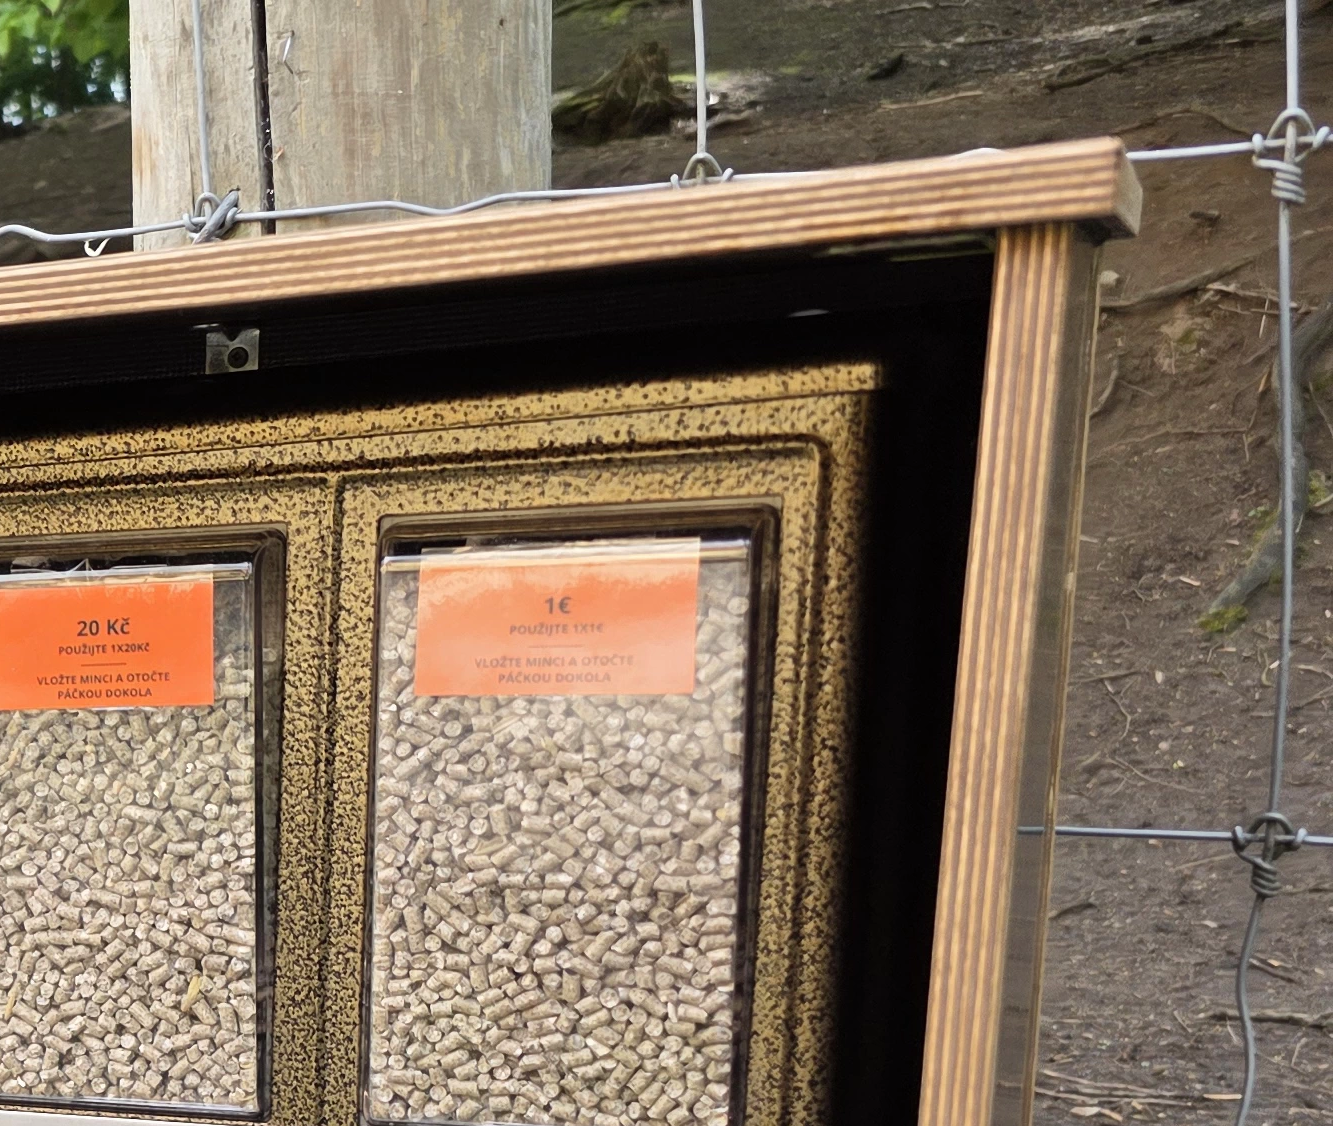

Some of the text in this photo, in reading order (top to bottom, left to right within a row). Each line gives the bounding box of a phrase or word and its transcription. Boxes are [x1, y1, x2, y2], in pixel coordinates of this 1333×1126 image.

[544, 596, 572, 614] 1€
[77, 617, 130, 637] 20 Kč
[509, 623, 604, 636] POUŽIJTE 1X1€
[58, 643, 107, 656] POUŽIJTE
[474, 653, 634, 669] VLOŽTE MINCI A OTOČTE
[37, 670, 170, 686] VLOŽTE MINCI A OTOČTE
[498, 671, 611, 684] PÁČKOU DOKOLA
[58, 688, 152, 700] PÁČKOU DOKOLA
